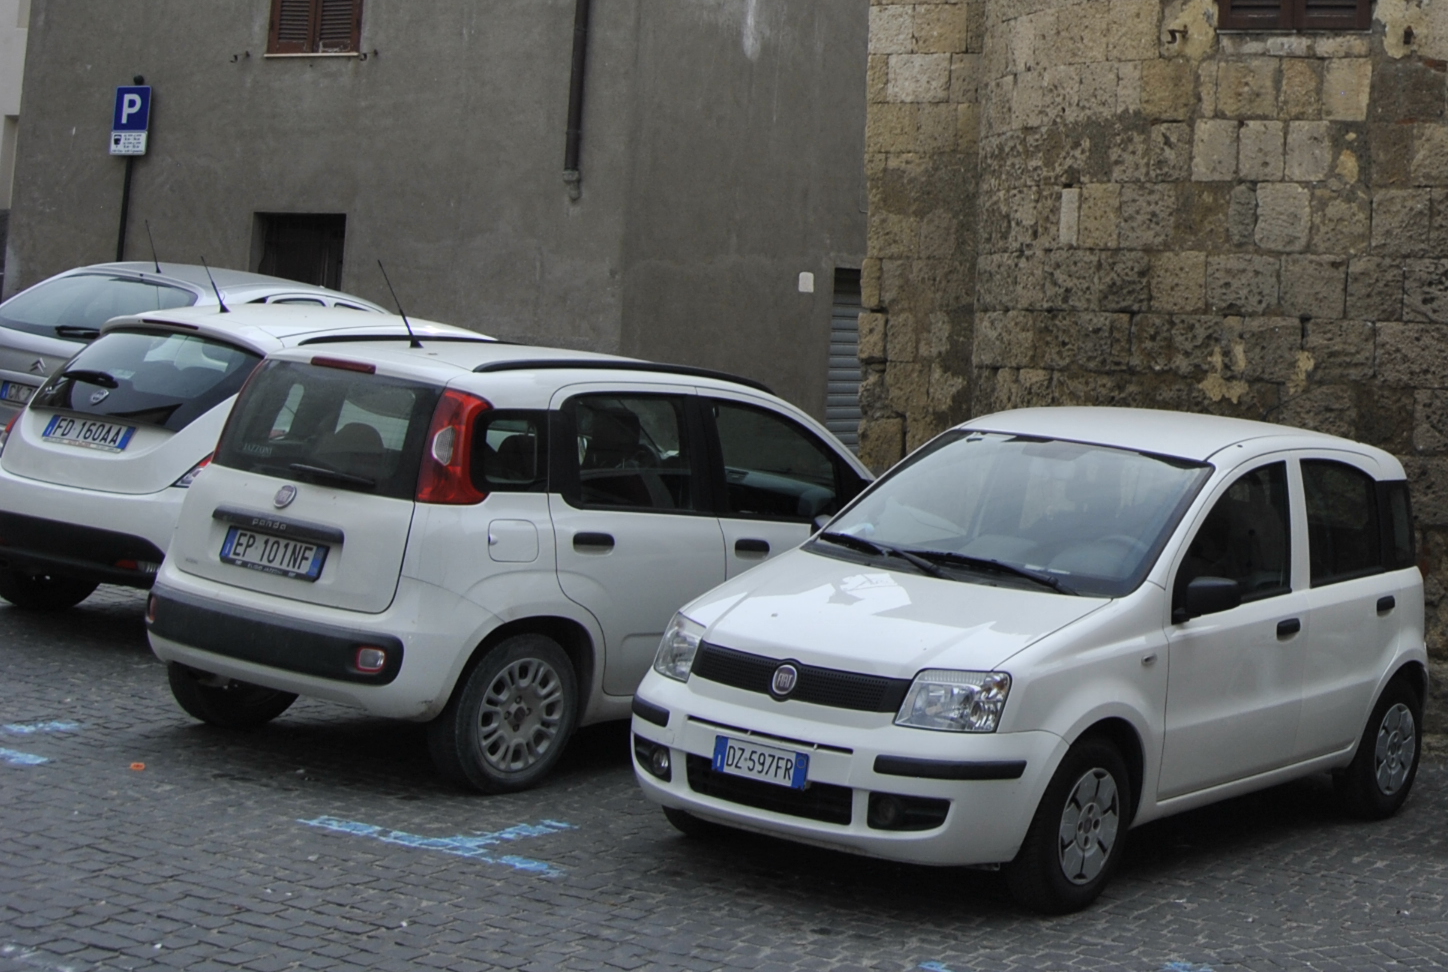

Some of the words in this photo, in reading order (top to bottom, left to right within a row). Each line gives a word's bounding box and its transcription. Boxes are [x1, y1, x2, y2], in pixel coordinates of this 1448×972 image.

[121, 93, 142, 124] P
[252, 518, 287, 530] panda
[776, 673, 793, 688] FIAT
